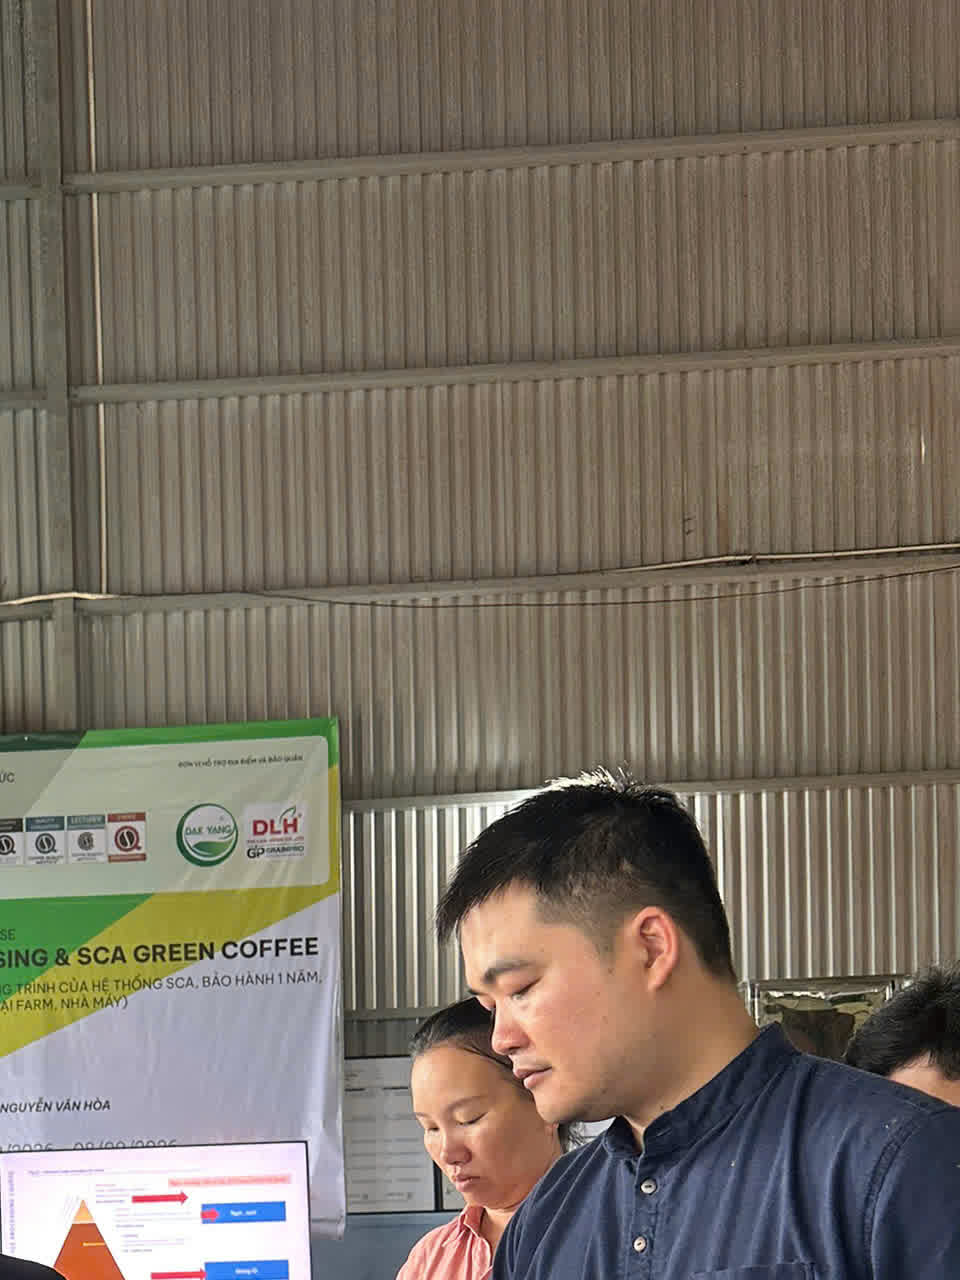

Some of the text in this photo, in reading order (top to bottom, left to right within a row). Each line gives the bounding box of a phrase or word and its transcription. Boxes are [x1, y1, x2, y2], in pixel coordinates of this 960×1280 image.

[206, 825, 232, 835] YANG
[252, 817, 298, 836] DLH
[54, 946, 71, 966] &
[77, 945, 127, 965] SCA
[133, 942, 214, 963] GREEN
[221, 937, 319, 959] COFFEE
[166, 976, 199, 990] SCA,
[235, 970, 274, 986] HÀNH
[16, 998, 57, 1012] FARM,
[60, 994, 90, 1008] NHÀ
[55, 1097, 82, 1112] VĂN
[83, 1097, 111, 1111] HÒA
